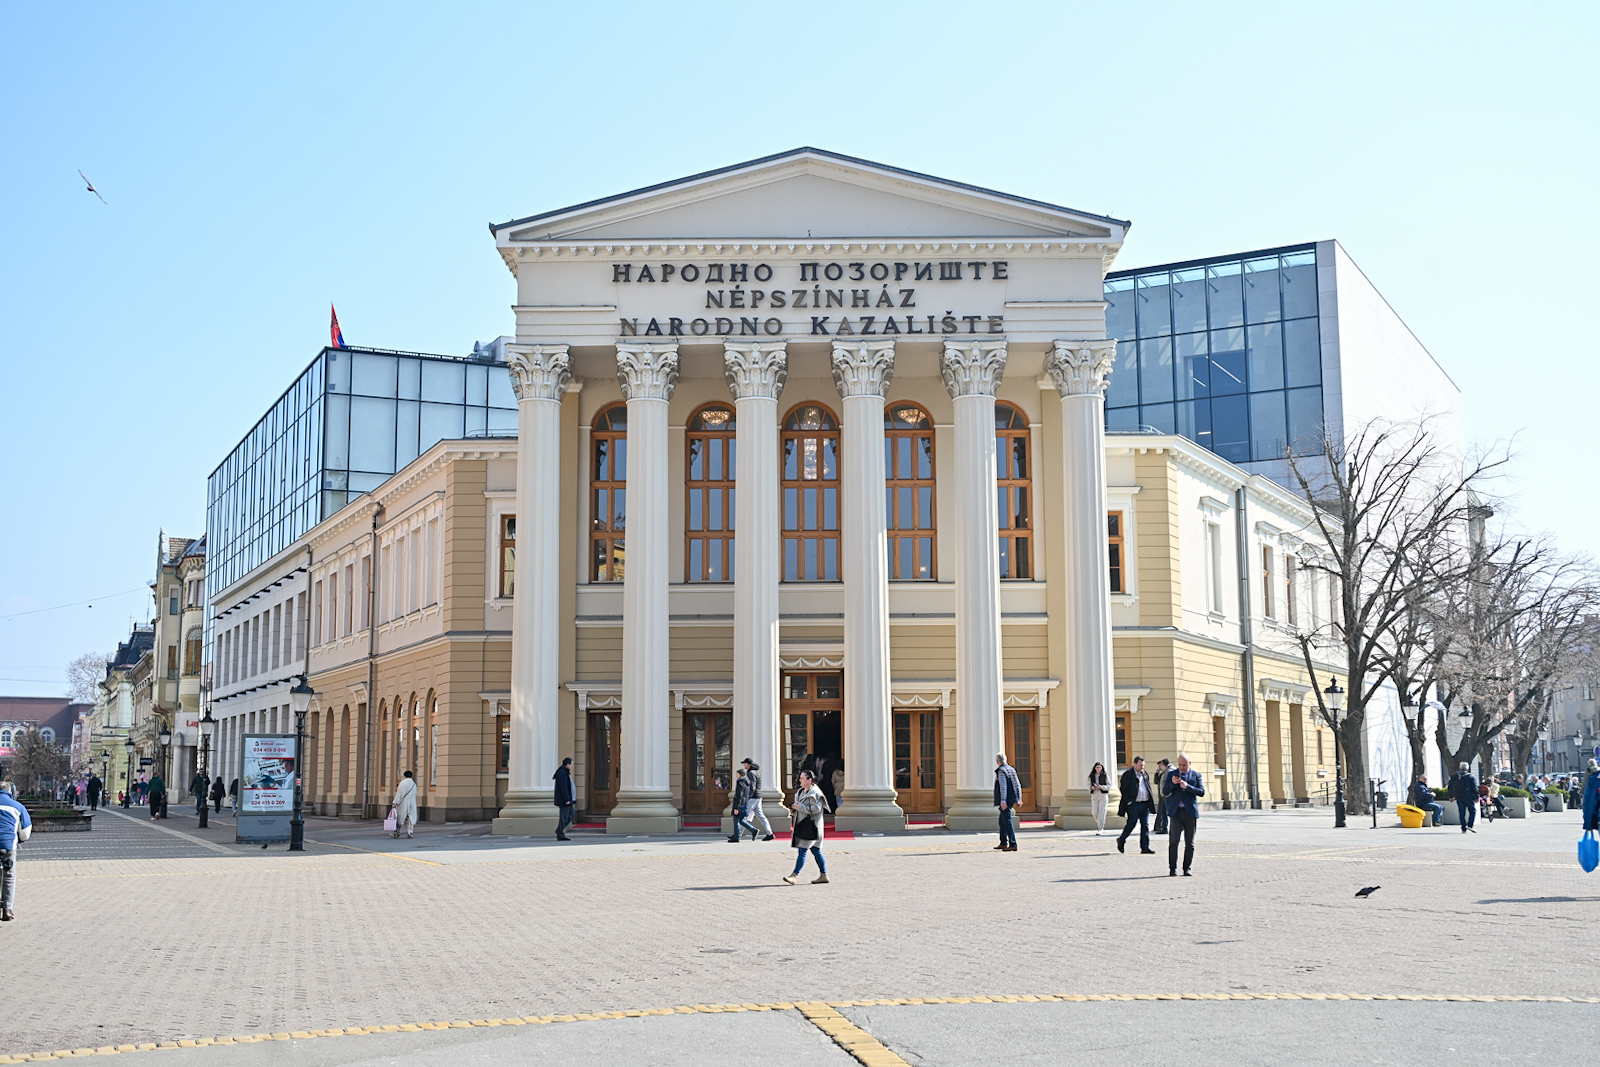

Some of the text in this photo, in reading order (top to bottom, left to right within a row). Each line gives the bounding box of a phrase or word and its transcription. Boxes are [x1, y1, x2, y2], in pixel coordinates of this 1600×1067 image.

[612, 261, 1008, 283] НАРОДНО ПОЗОРИШТЕ
[705, 284, 915, 308] NÉPSZÍNHÁZ
[619, 311, 1004, 336] NARODNO KAZALIŠTE
